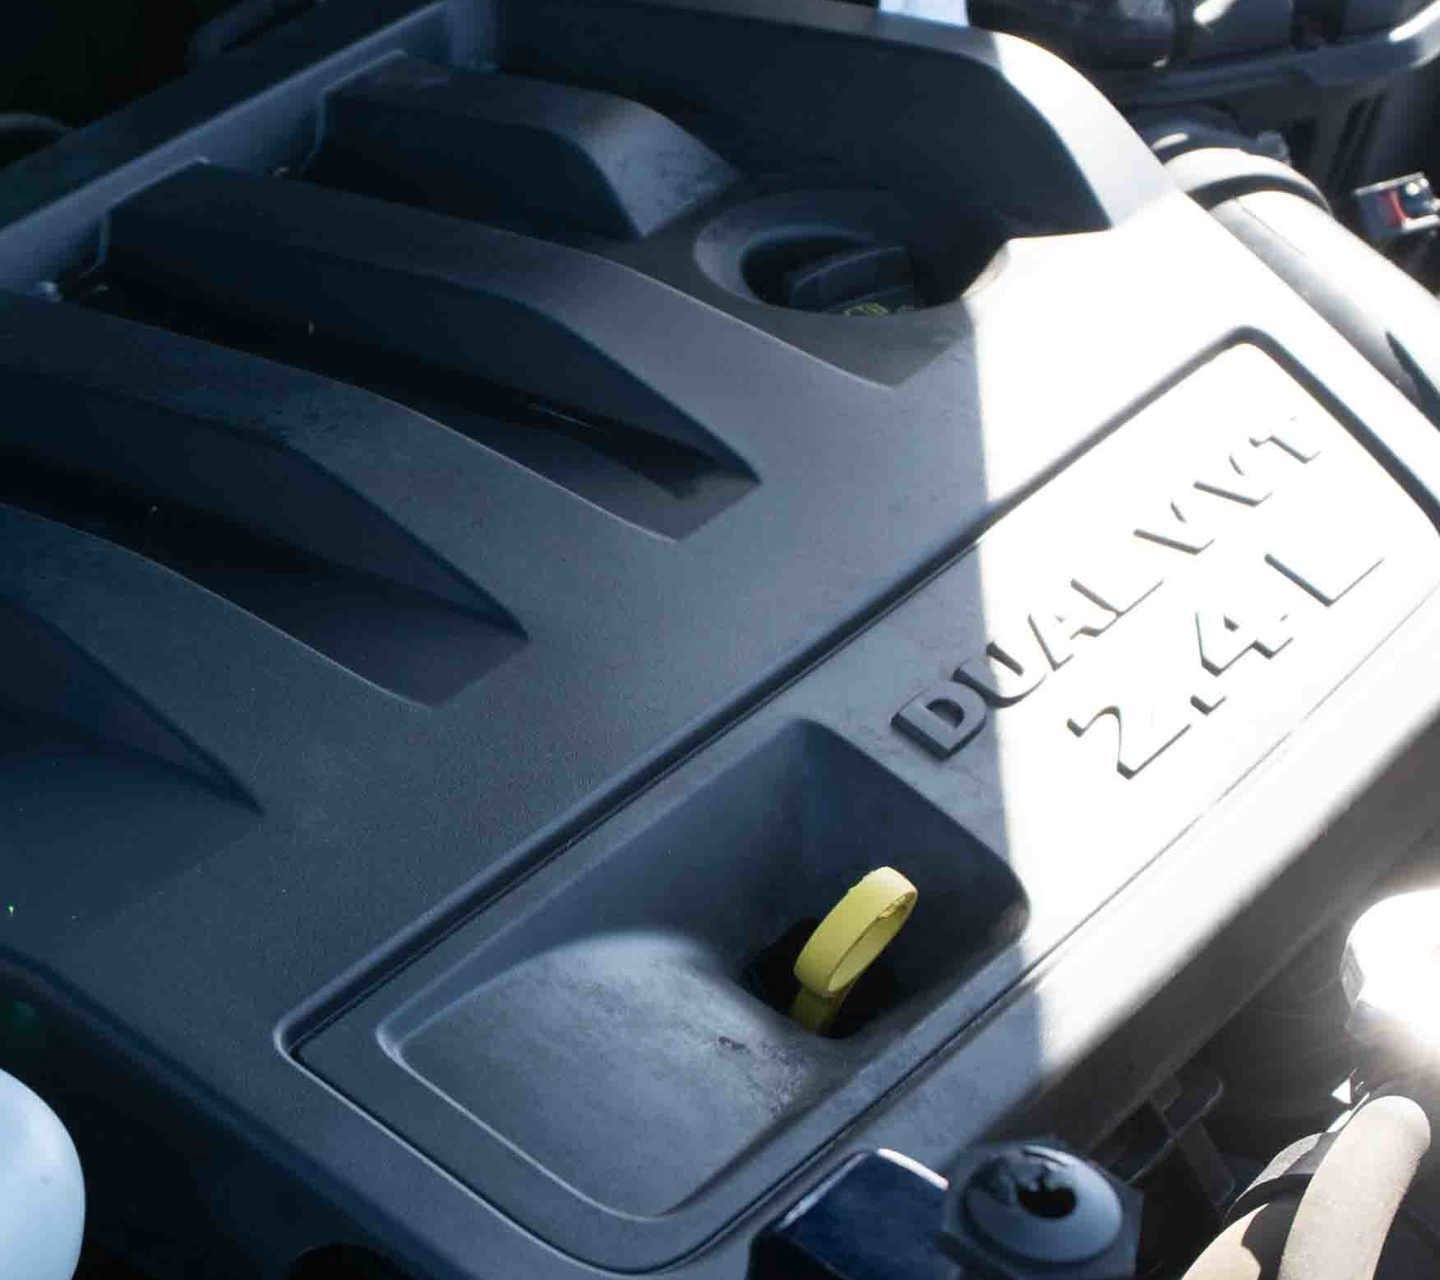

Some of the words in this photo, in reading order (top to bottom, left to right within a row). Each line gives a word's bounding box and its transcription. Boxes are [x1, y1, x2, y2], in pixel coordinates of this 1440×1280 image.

[889, 576, 1164, 760] DUAL
[1133, 416, 1322, 556] VVT
[1066, 553, 1385, 780] 2.4L
